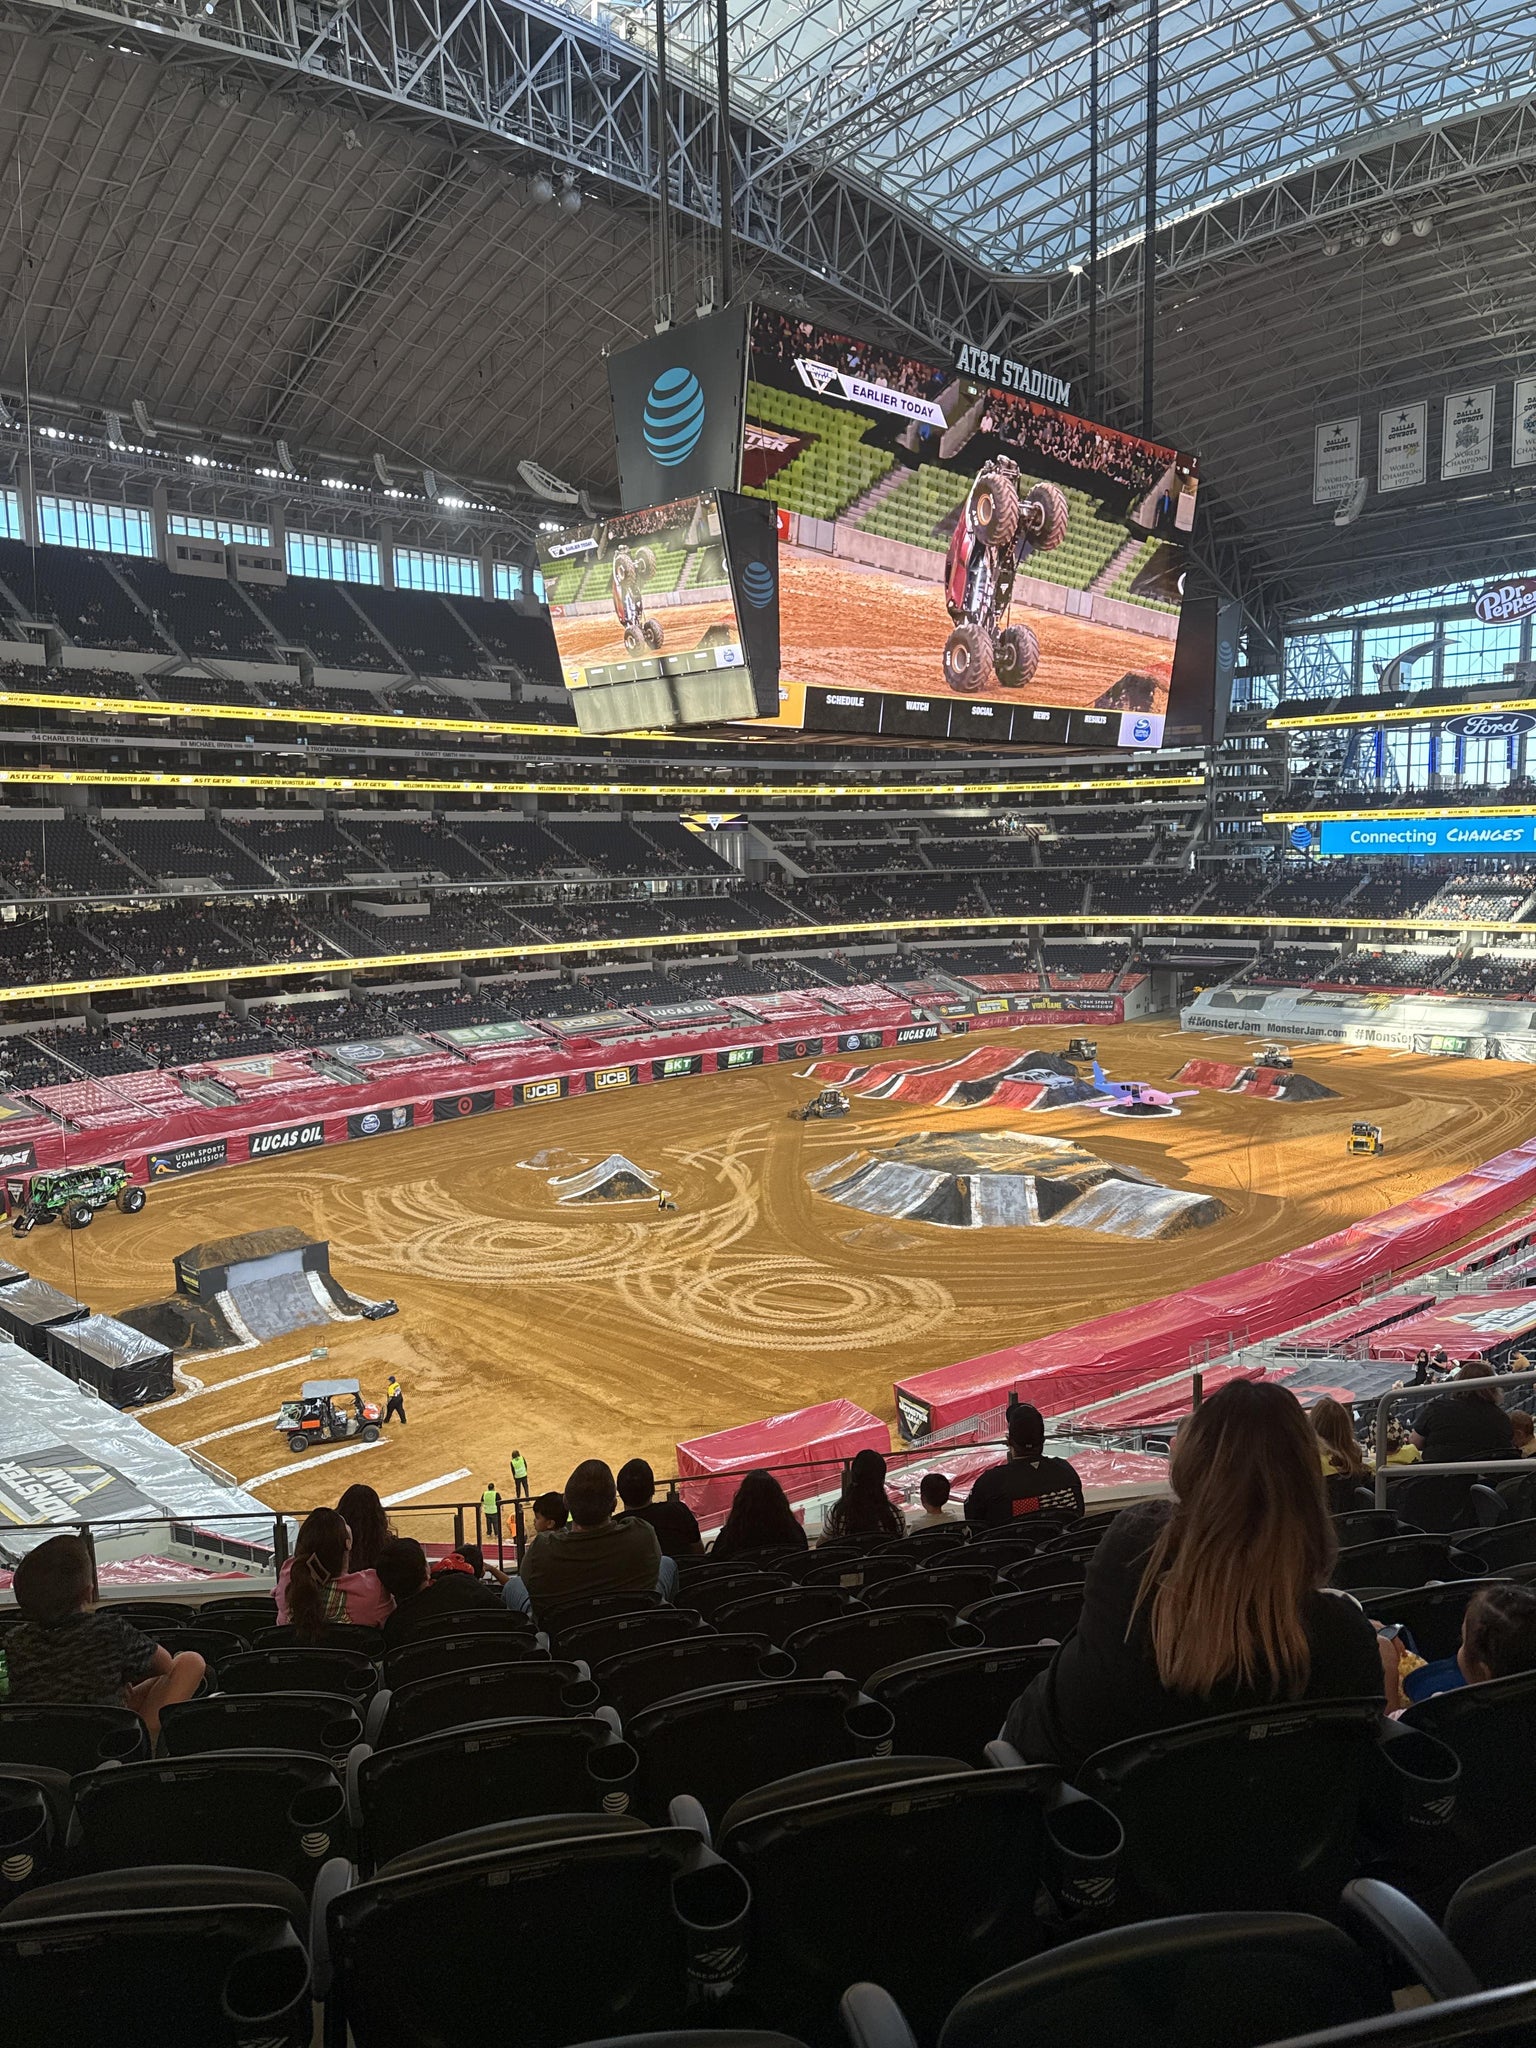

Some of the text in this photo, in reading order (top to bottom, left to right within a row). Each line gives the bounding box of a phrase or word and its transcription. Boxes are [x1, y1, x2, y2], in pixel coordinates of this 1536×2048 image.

[956, 344, 1071, 407] AT&T STADIUM
[852, 385, 934, 418] EARLIER TODAY
[1453, 414, 1484, 426] COWBOYS
[1456, 408, 1481, 418] DALLAS
[1388, 429, 1417, 440] COWBOYS
[1391, 423, 1415, 433] DALLAS
[1323, 443, 1351, 453] COWBOYS
[1326, 437, 1348, 446] DALLAS
[1454, 449, 1480, 458] WORLD
[1390, 462, 1414, 472] WORLD
[1445, 455, 1488, 468] CHAMPIONS
[1382, 468, 1422, 480] CHAMPIONS
[1394, 478, 1410, 486] 1977
[1499, 586, 1526, 604] Dr
[826, 694, 864, 707] SCHEDULE
[906, 700, 930, 712] WATCH
[971, 706, 994, 717] SOCIAL
[1032, 710, 1050, 721] NEWS
[1084, 715, 1107, 724] RESULTS
[1462, 716, 1519, 734] Ford
[1350, 828, 1524, 846] Connecting CHANGES
[650, 1004, 717, 1018] LUCAS OIL
[450, 1024, 519, 1041] BKT
[898, 1026, 938, 1042] LUCAS OIL
[1188, 1016, 1261, 1032] #MonsterJam
[1267, 1023, 1348, 1038] MonsterJam.com
[1432, 1038, 1467, 1050] BKT
[728, 1050, 753, 1064] BKT
[664, 1058, 691, 1072] BKT
[598, 1072, 627, 1086] JCB
[527, 1084, 558, 1099] JCB
[252, 1126, 322, 1153] LUCAS OIL
[176, 1144, 225, 1162] UTAH SPORTS
[176, 1152, 225, 1168] COMMISSION
[0, 1460, 82, 1523] MONSTER
[32, 1468, 92, 1503] JAM
